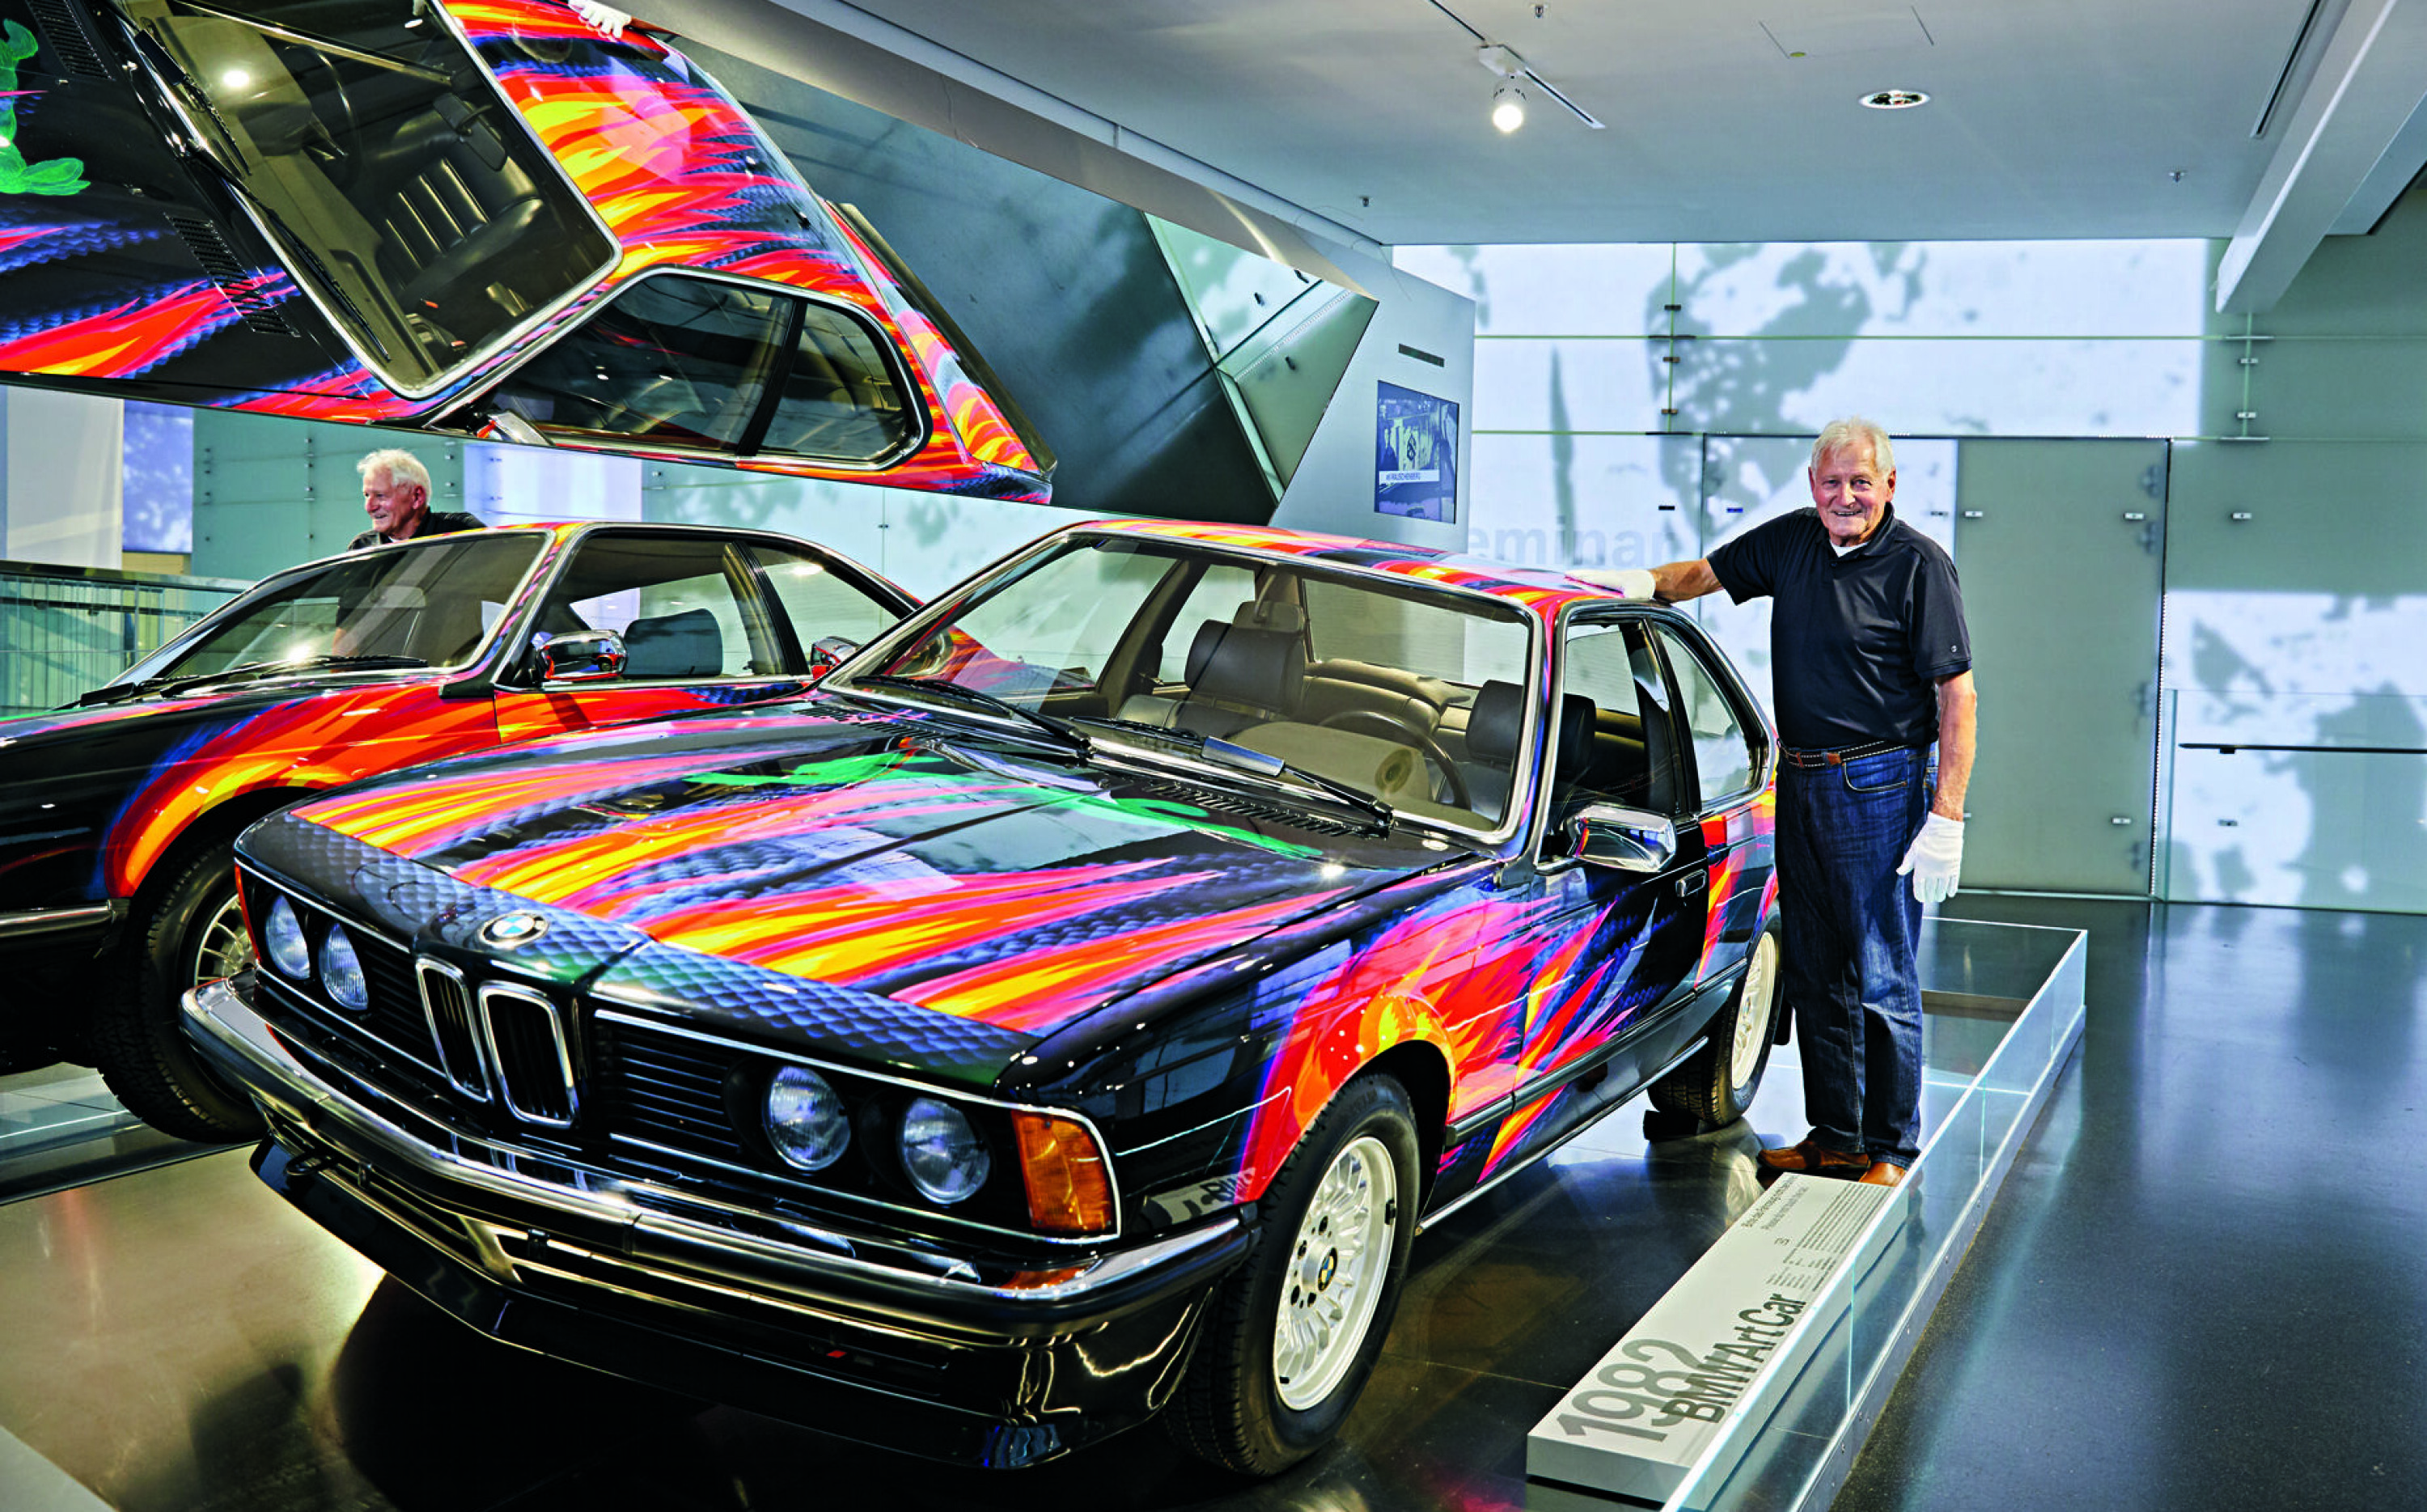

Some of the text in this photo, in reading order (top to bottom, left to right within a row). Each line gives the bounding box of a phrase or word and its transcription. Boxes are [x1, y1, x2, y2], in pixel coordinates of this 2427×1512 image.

[1468, 515, 1671, 567] eminar
[1739, 1293, 1806, 1327] Car
[1713, 1326, 1785, 1363] Art
[1557, 1339, 1730, 1442] 1982
[1661, 1356, 1758, 1423] BMW
